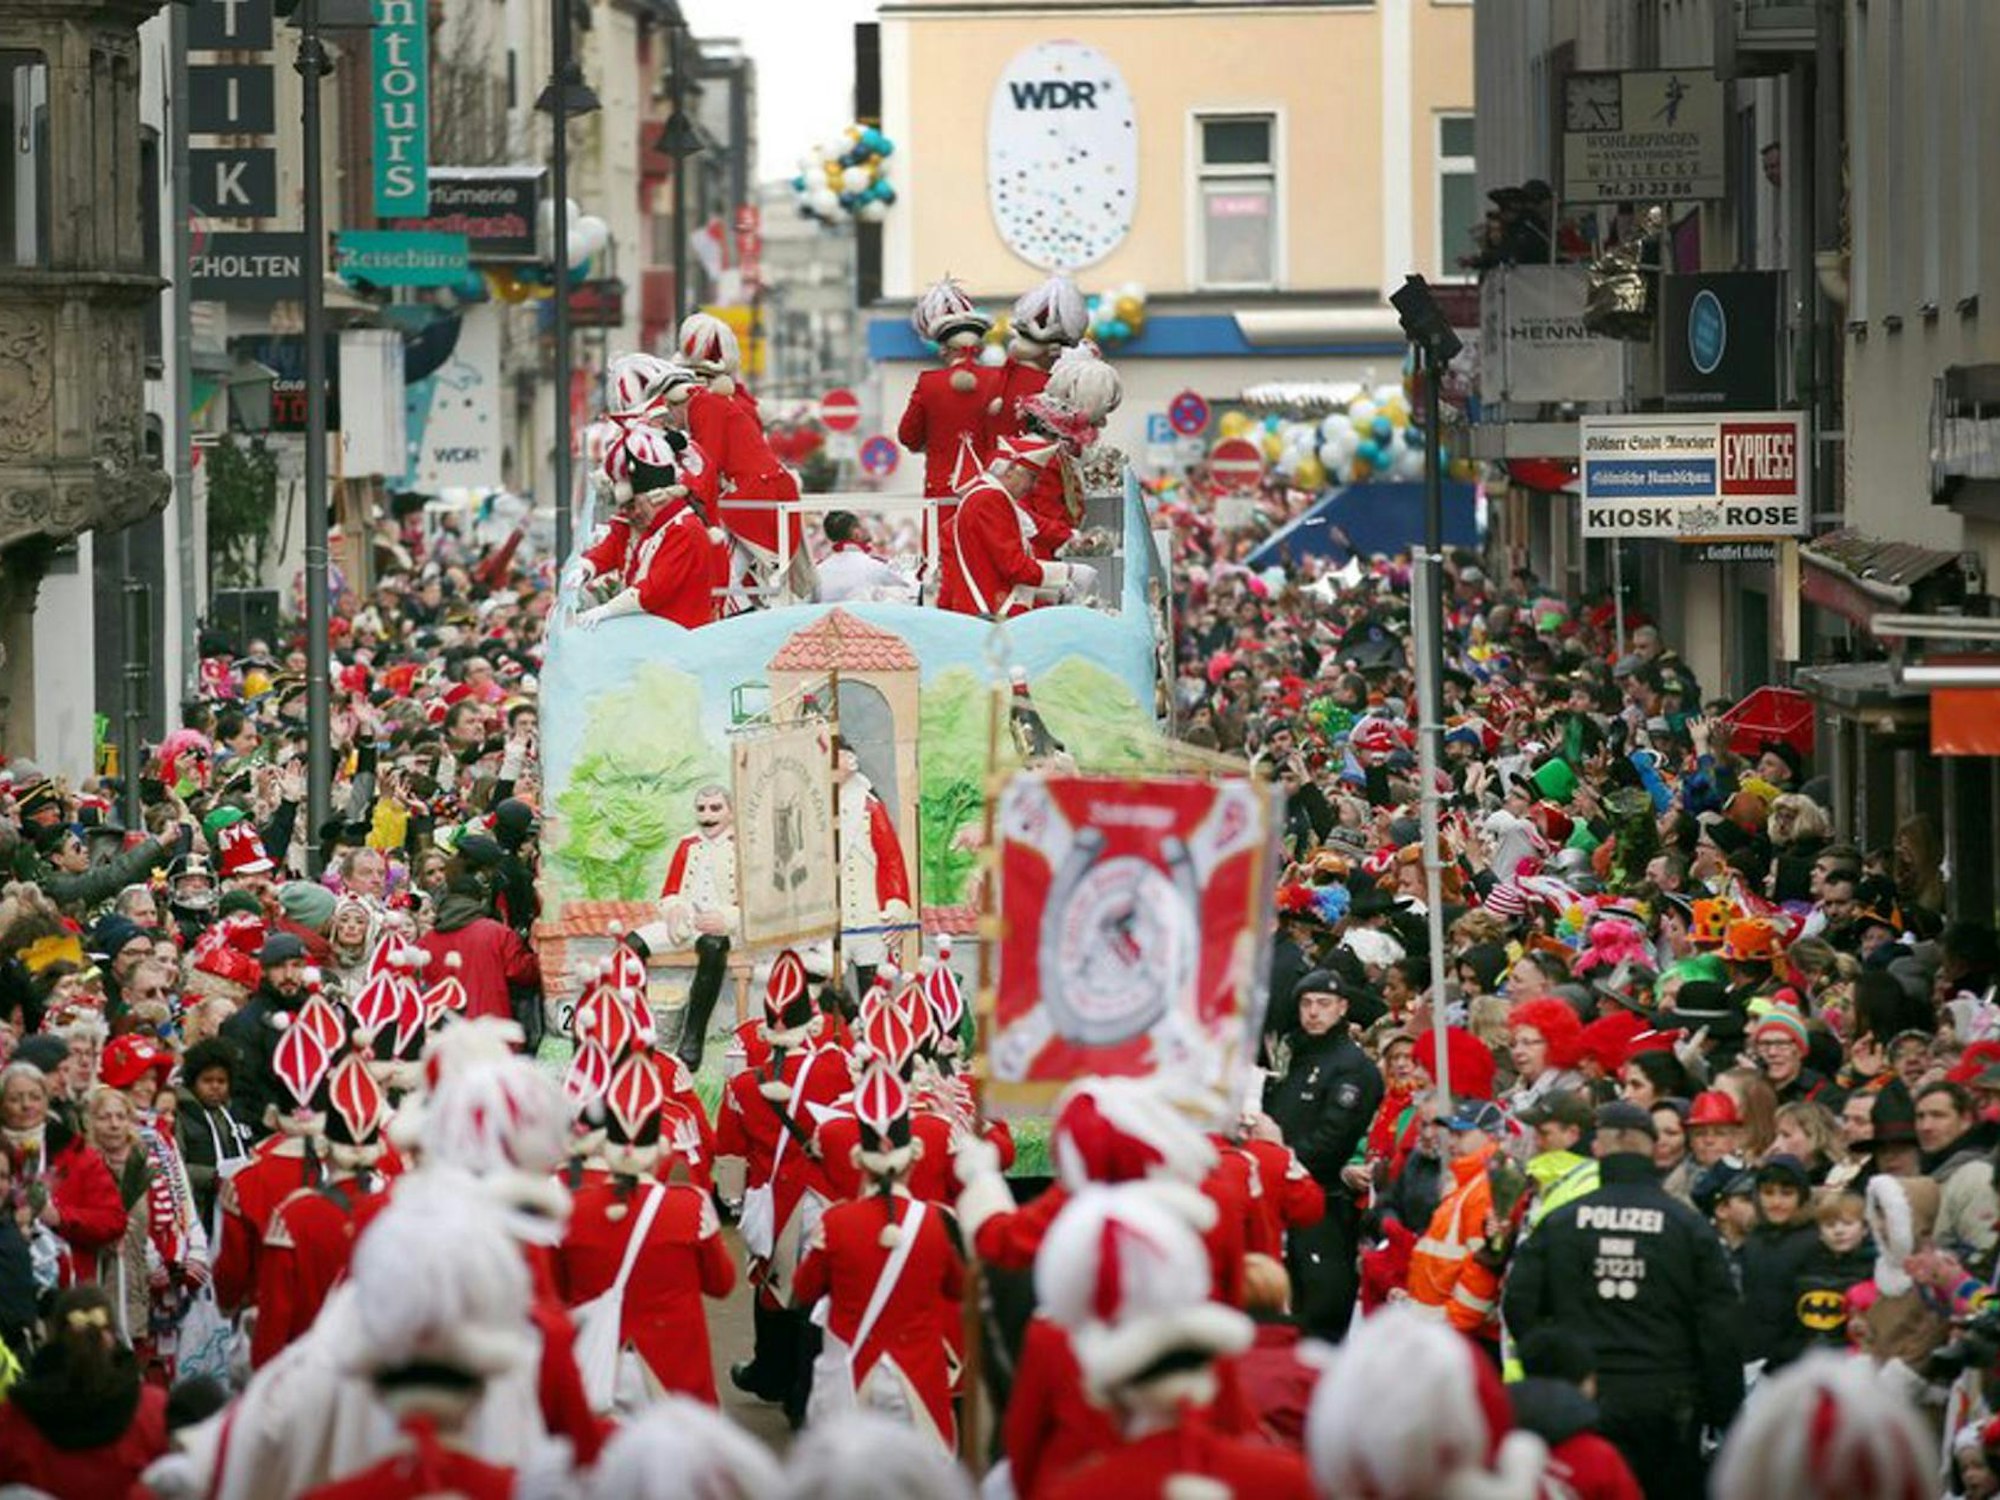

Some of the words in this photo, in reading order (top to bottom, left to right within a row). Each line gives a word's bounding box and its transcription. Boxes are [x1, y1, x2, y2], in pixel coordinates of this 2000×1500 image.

[381, 0, 418, 198] ntours
[1009, 81, 1098, 110] WDR
[1597, 183, 1624, 196] Tel.
[433, 447, 480, 462] WDR
[1724, 433, 1794, 481] EXPRESS
[1588, 508, 1673, 528] KIOSK
[1726, 506, 1799, 525] ROSE
[1576, 1205, 1664, 1234] POLIZEI
